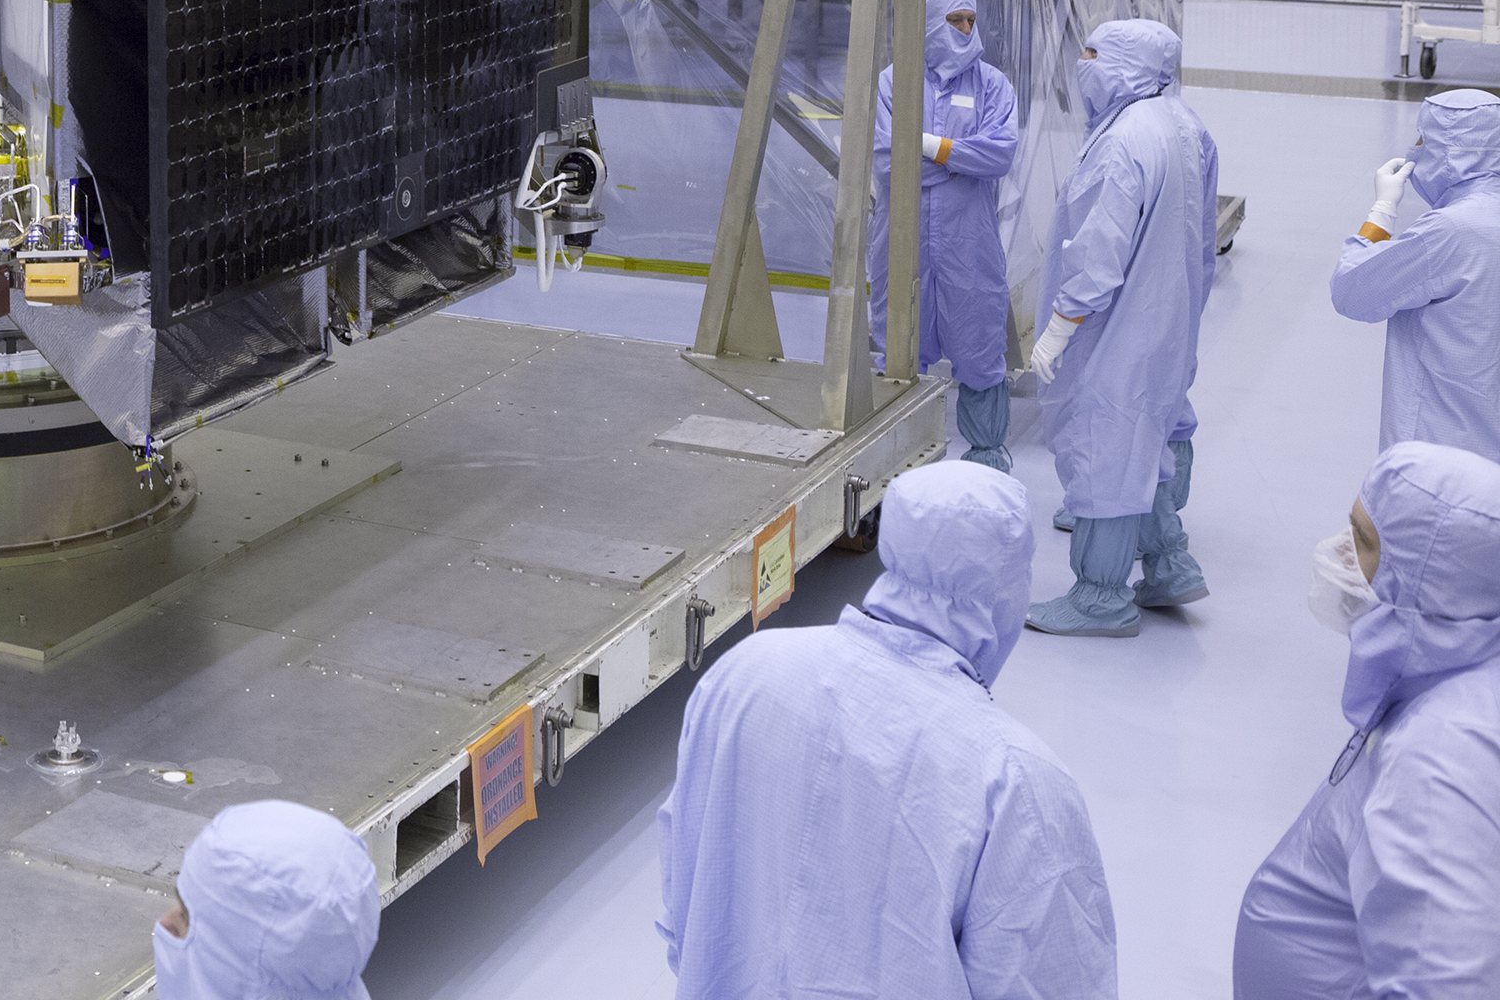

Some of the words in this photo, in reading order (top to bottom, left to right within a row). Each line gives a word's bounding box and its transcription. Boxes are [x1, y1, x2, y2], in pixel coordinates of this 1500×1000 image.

[485, 731, 518, 772] WARNING!
[481, 755, 523, 807] ORDNANCE
[484, 780, 524, 831] INSTALLED
